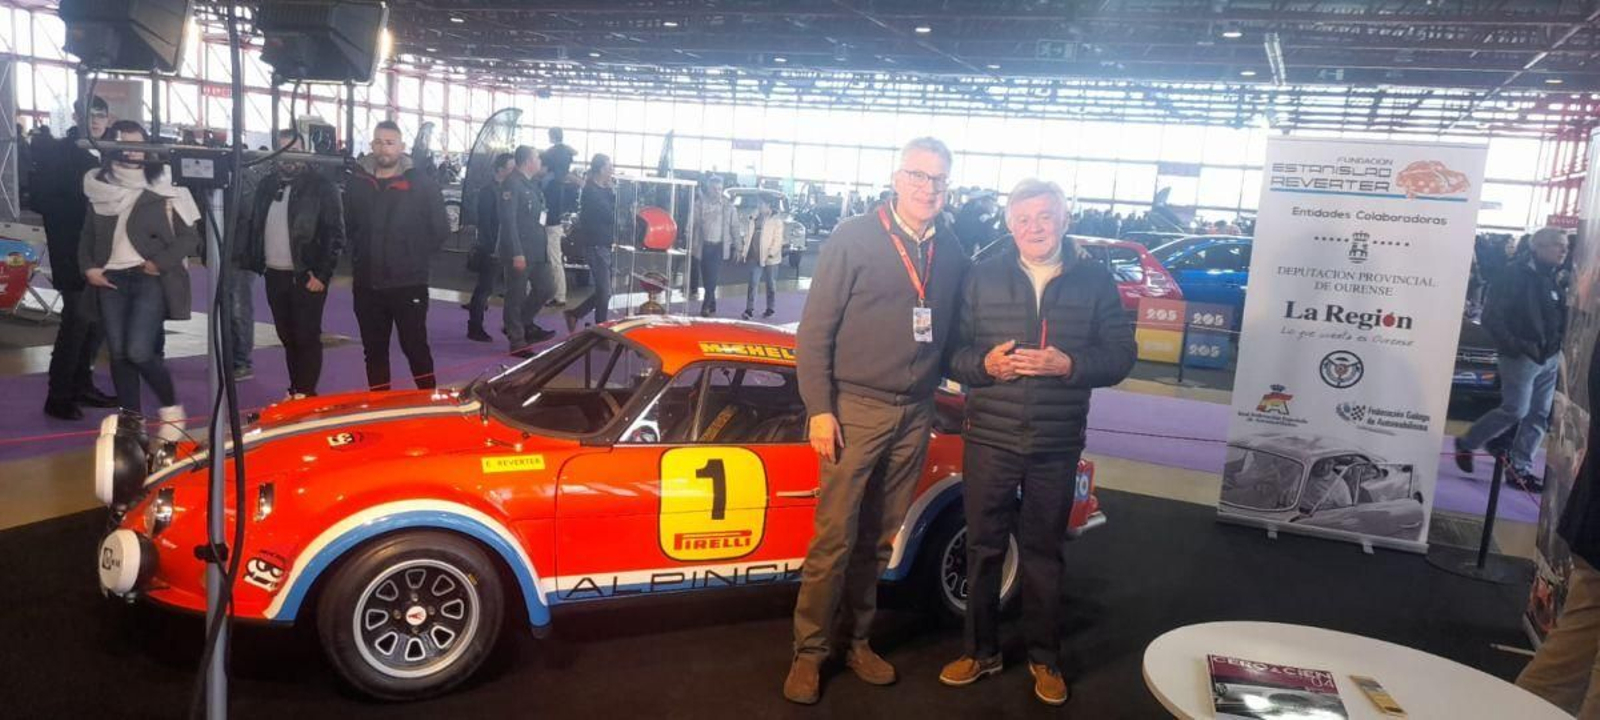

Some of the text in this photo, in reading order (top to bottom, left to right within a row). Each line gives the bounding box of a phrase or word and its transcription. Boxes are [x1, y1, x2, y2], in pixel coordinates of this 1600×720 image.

[1272, 163, 1392, 178] ESTANISLAO
[1270, 176, 1390, 192] REVERTER
[1292, 206, 1447, 225] Entidades Colaboradoras
[1359, 272, 1437, 288] PROVINCIAL
[1314, 281, 1393, 297] DE OURENSE
[1146, 308, 1178, 321] 205
[1284, 300, 1318, 321] La
[1193, 312, 1224, 326] 205
[1188, 344, 1220, 357] 205
[696, 458, 727, 520] 1
[674, 530, 752, 550] PIRELLI
